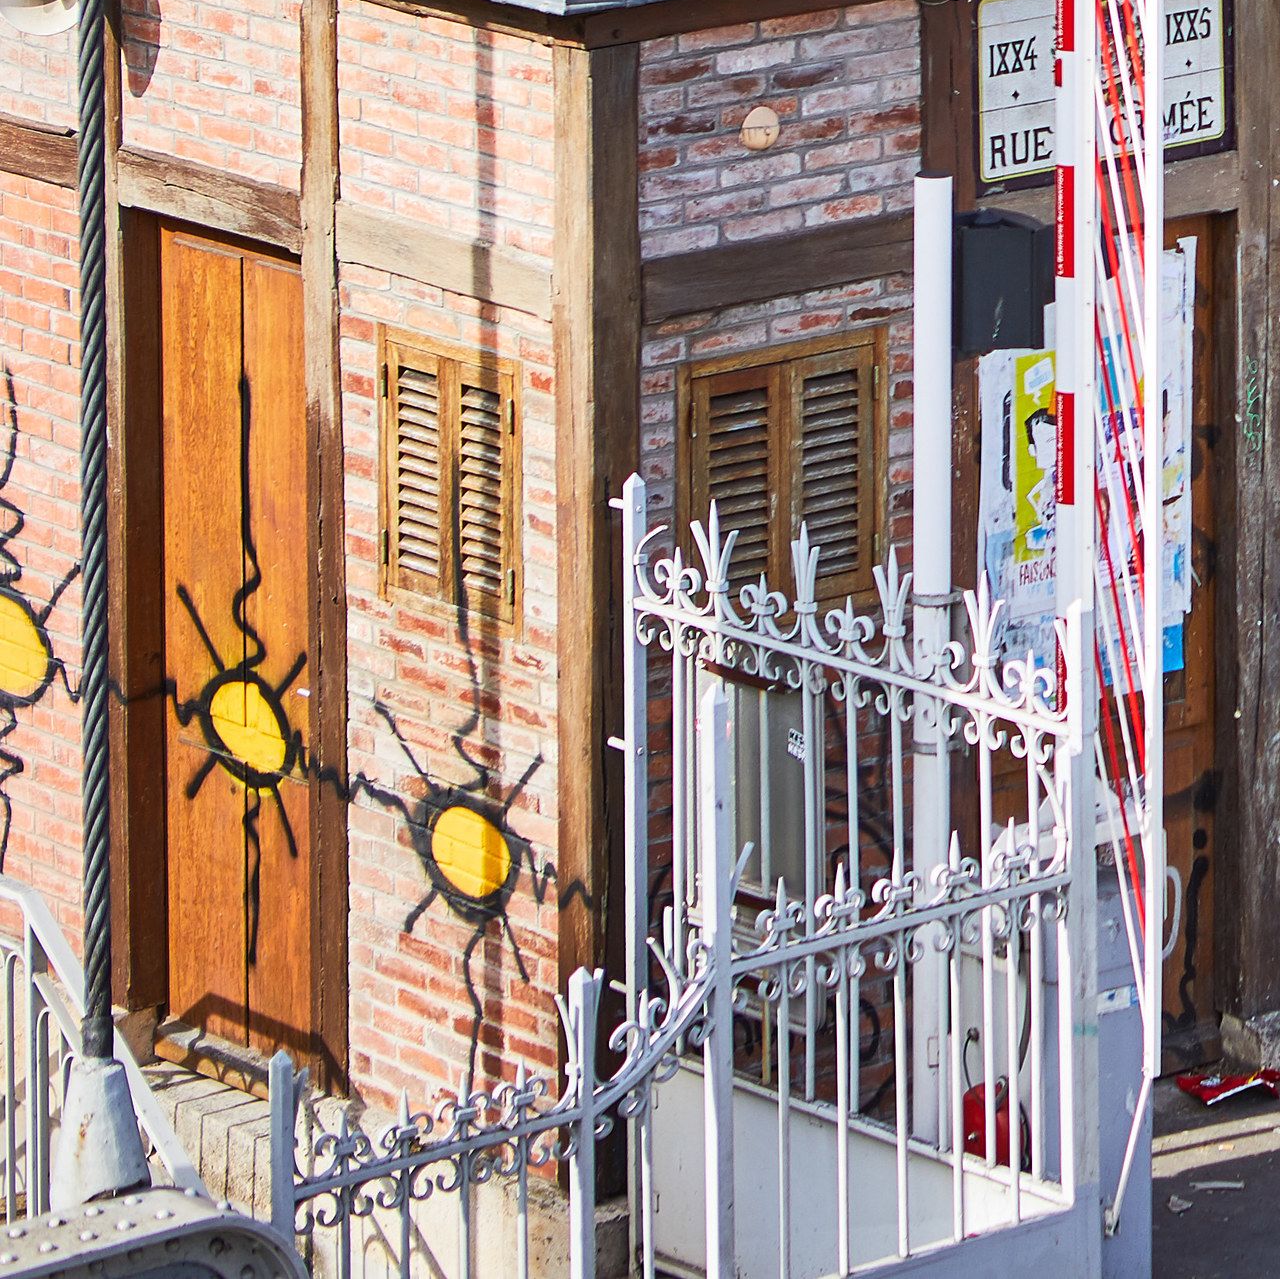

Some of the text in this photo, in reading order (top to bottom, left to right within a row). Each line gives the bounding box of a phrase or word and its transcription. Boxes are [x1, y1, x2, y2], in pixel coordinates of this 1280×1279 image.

[1165, 7, 1212, 46] 1885
[989, 36, 1038, 77] 1884
[989, 126, 1054, 170] RUE
